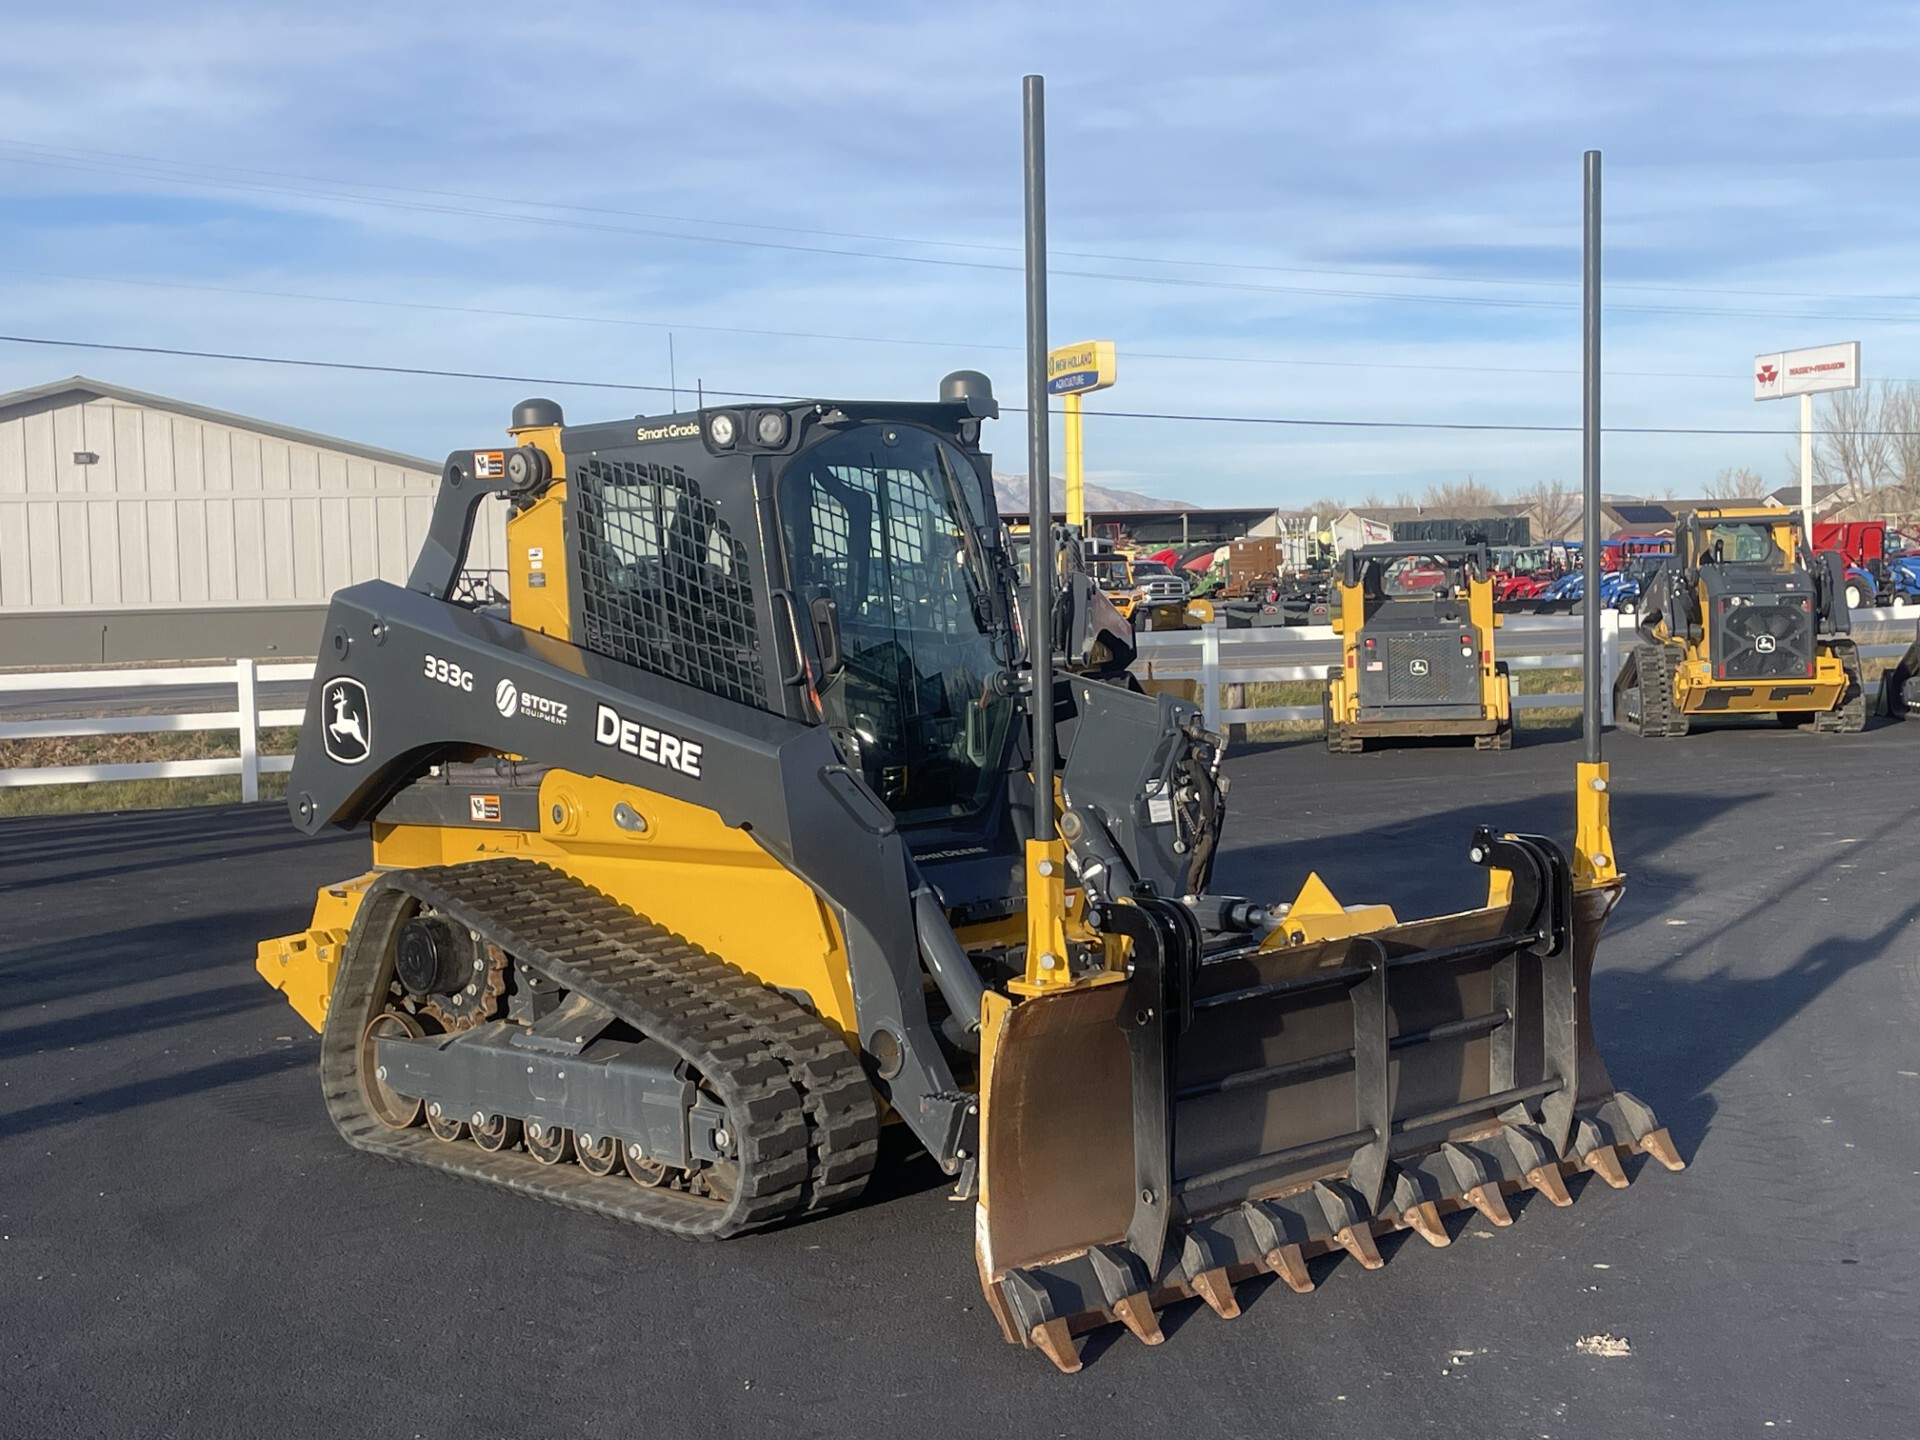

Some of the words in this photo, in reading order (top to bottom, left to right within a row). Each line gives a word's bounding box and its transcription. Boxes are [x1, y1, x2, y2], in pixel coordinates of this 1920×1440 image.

[1056, 359, 1066, 372] NEW
[1067, 352, 1092, 369] HOLLAND
[1055, 374, 1085, 389] AGRICULTURE
[424, 655, 473, 692] 333G
[521, 692, 568, 718] STOTZ
[520, 706, 568, 726] EQUIPMENT
[595, 703, 703, 779] DEERE
[942, 846, 988, 857] DEERE
